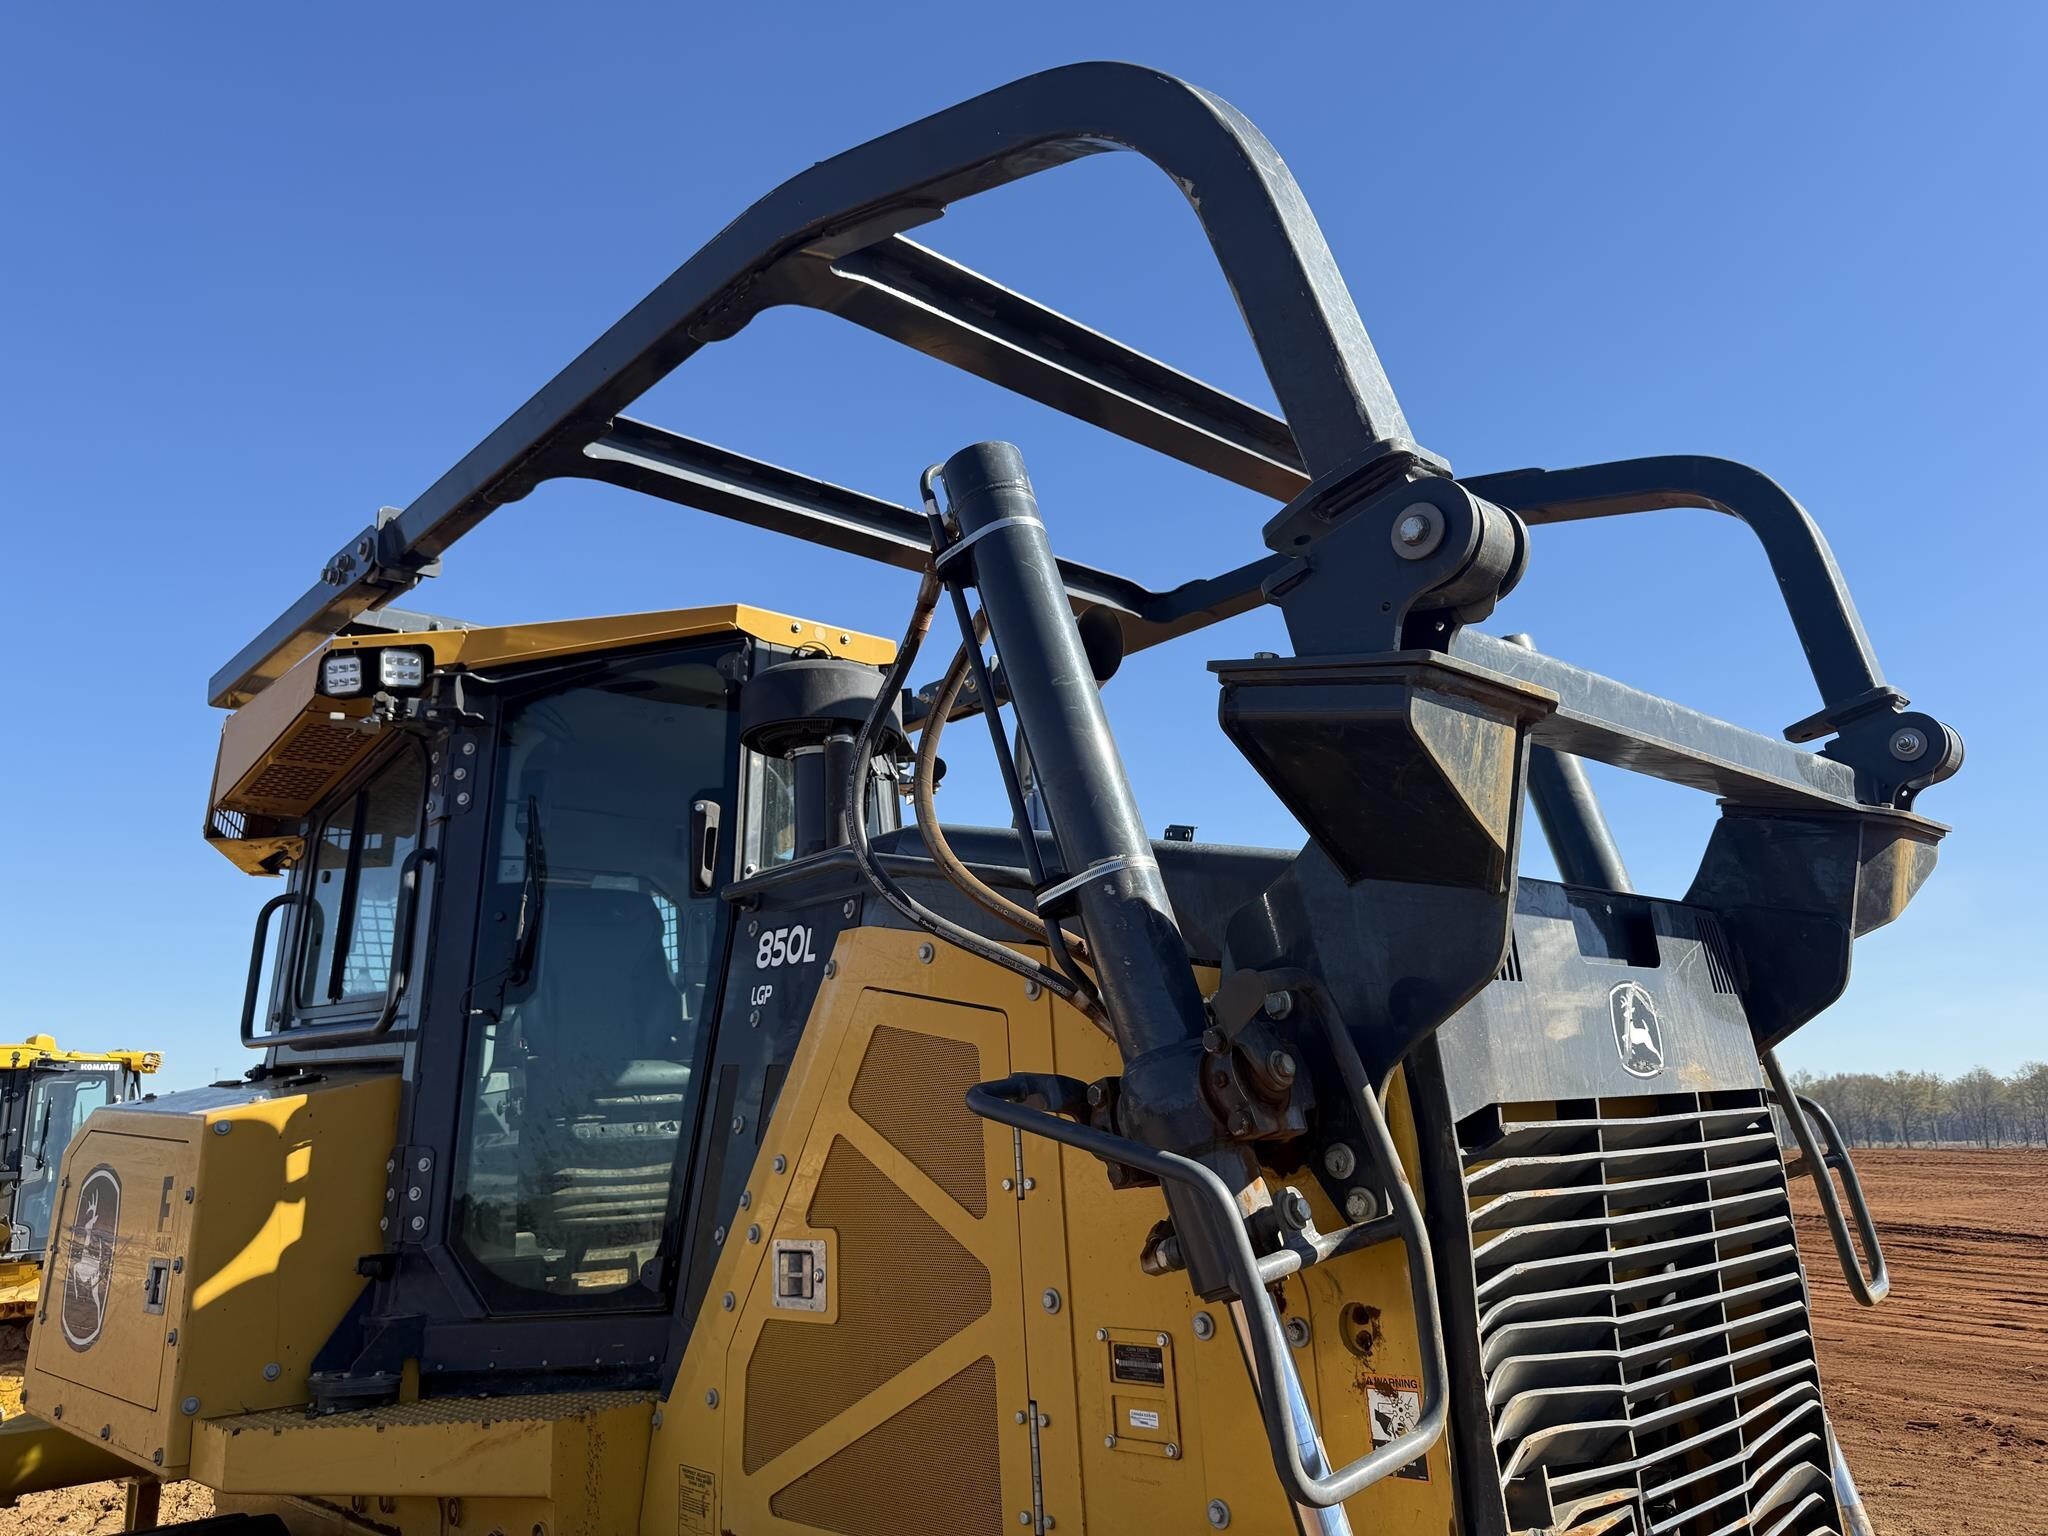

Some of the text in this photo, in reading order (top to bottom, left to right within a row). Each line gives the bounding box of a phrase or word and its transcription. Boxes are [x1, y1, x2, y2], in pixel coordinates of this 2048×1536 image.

[756, 925, 816, 969] 850L
[751, 985, 773, 1006] LGP
[80, 1062, 120, 1071] KOMATSU
[1374, 1376, 1418, 1389] WARNING
